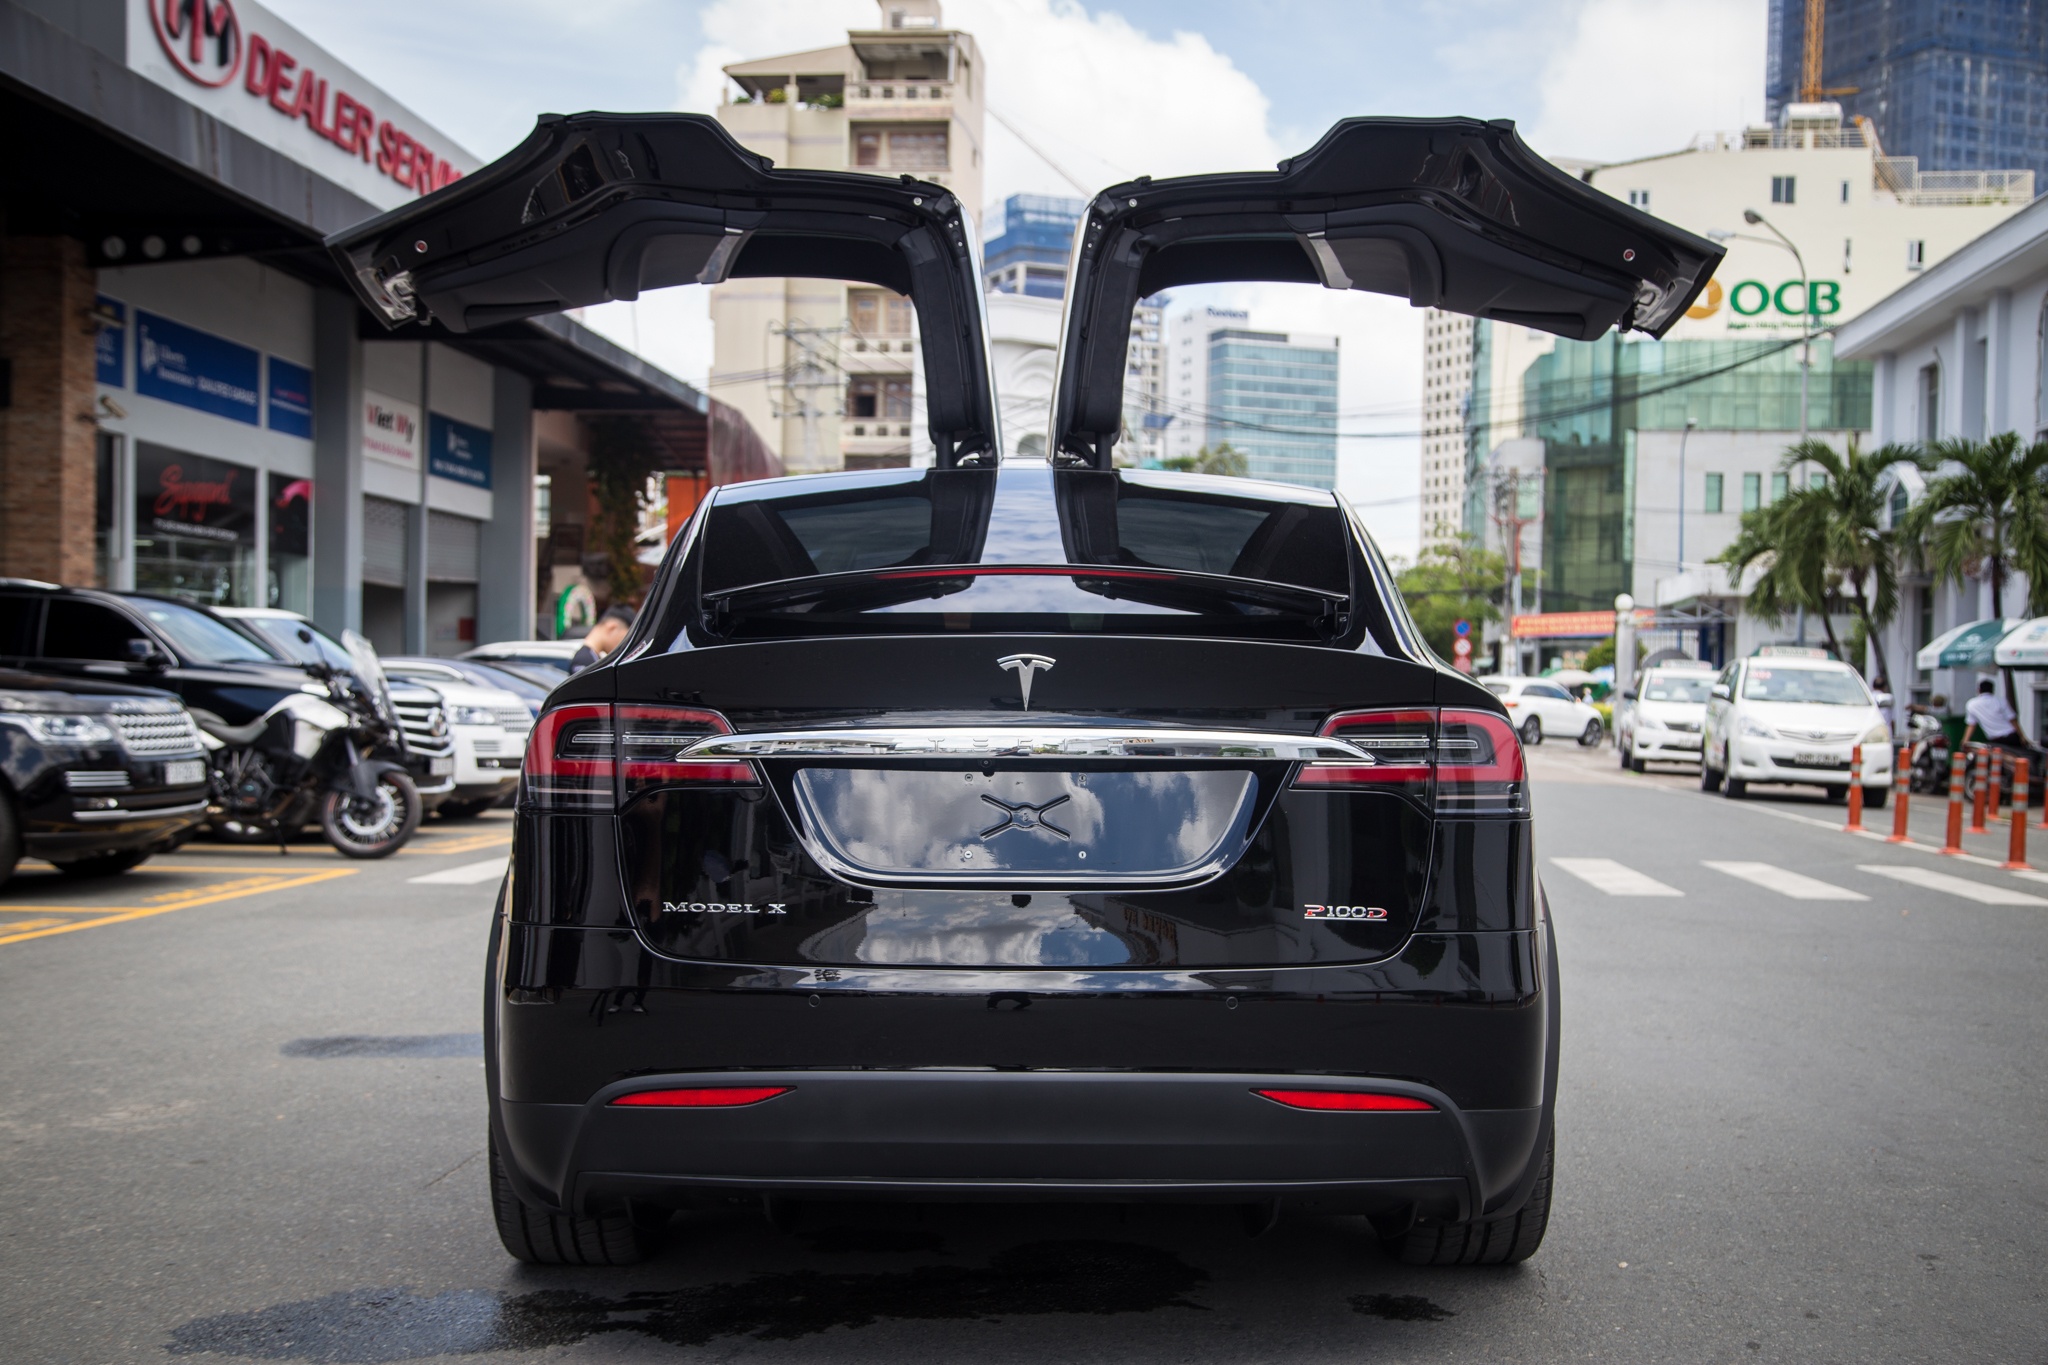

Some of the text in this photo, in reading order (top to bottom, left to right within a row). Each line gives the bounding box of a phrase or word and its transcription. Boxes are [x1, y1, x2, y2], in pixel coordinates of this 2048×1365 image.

[246, 32, 464, 197] DEALER SERVI
[1730, 279, 1842, 316] OCB
[662, 901, 787, 914] MODEL X
[1303, 904, 1388, 919] P100D
